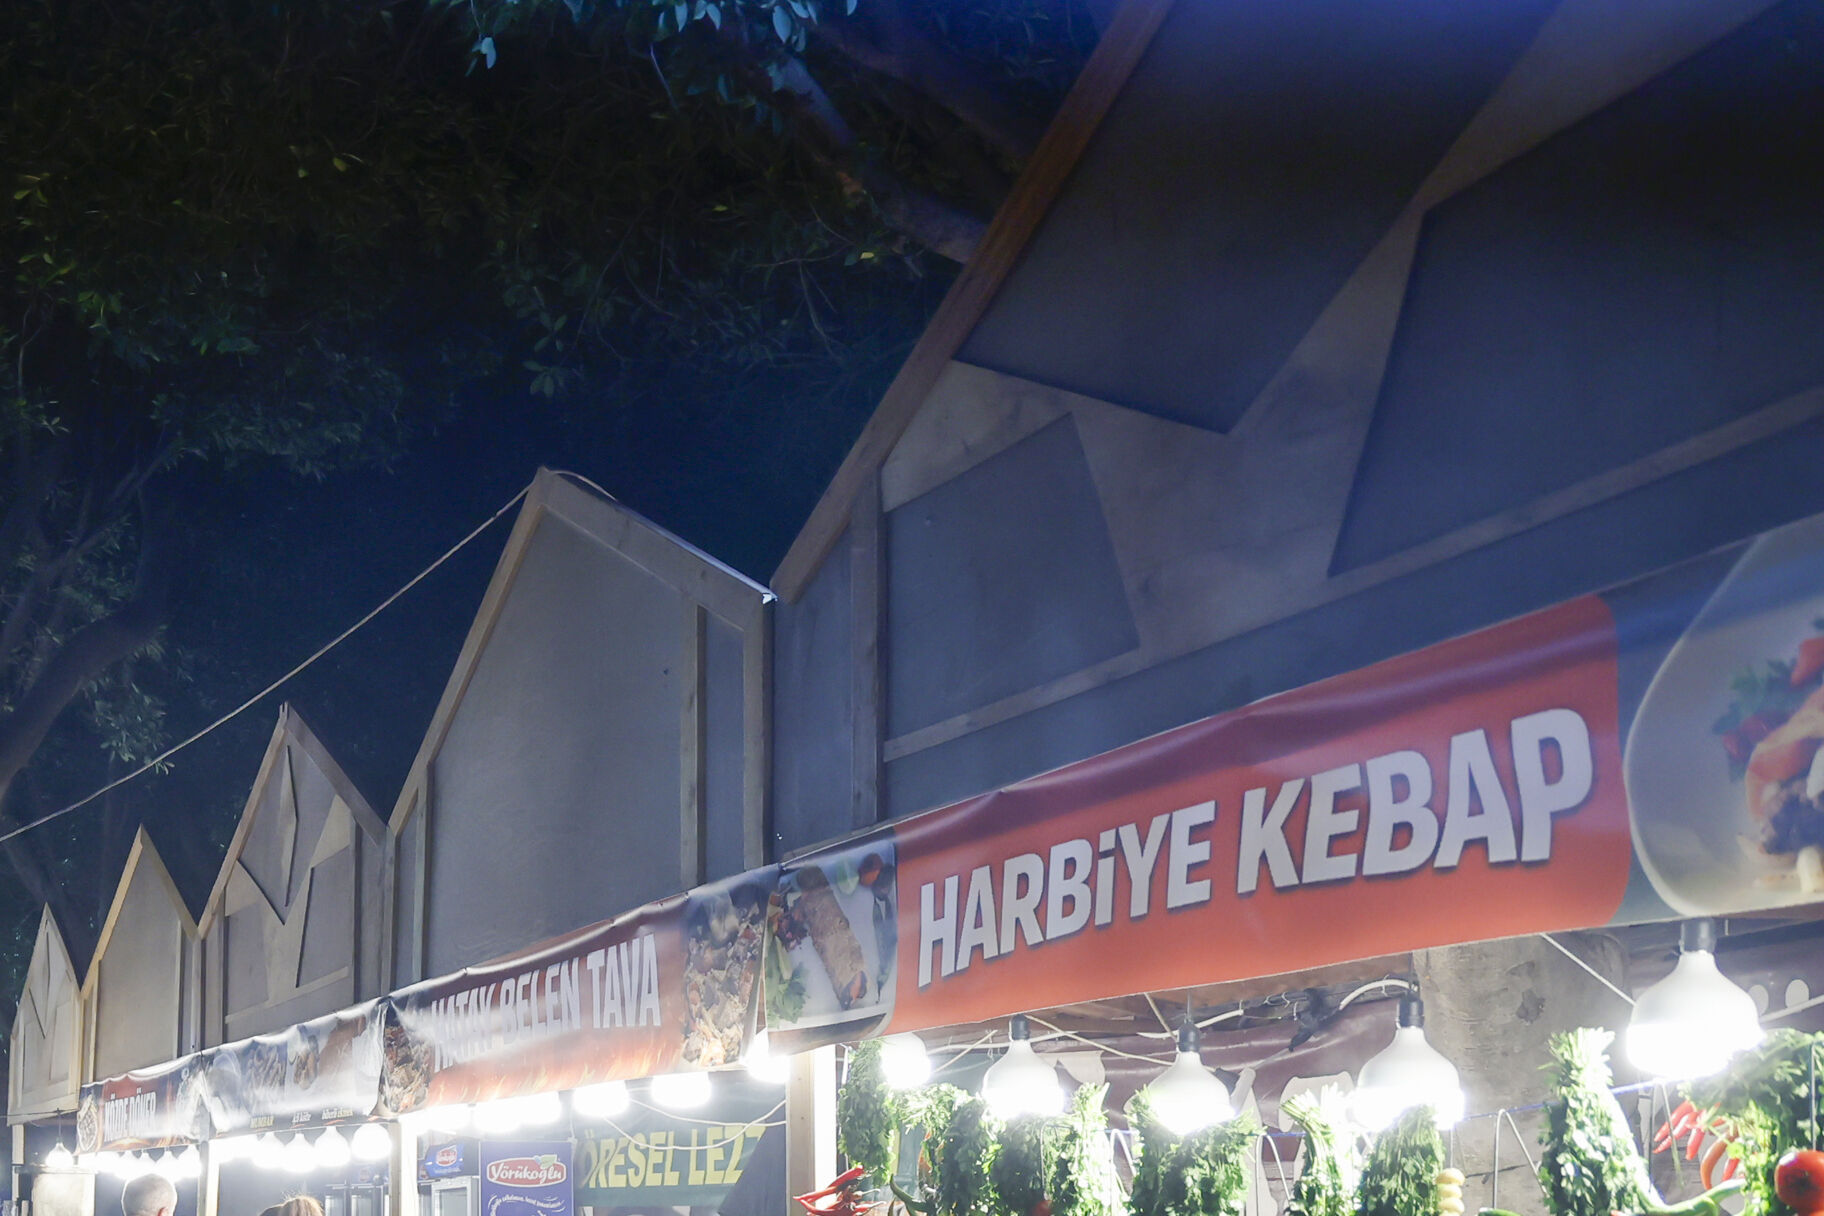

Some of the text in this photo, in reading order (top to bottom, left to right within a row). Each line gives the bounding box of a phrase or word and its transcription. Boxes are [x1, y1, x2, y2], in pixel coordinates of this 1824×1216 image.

[1236, 706, 1596, 896] KEBAP
[498, 956, 582, 1045] BELEN
[586, 931, 662, 1030] TAVA
